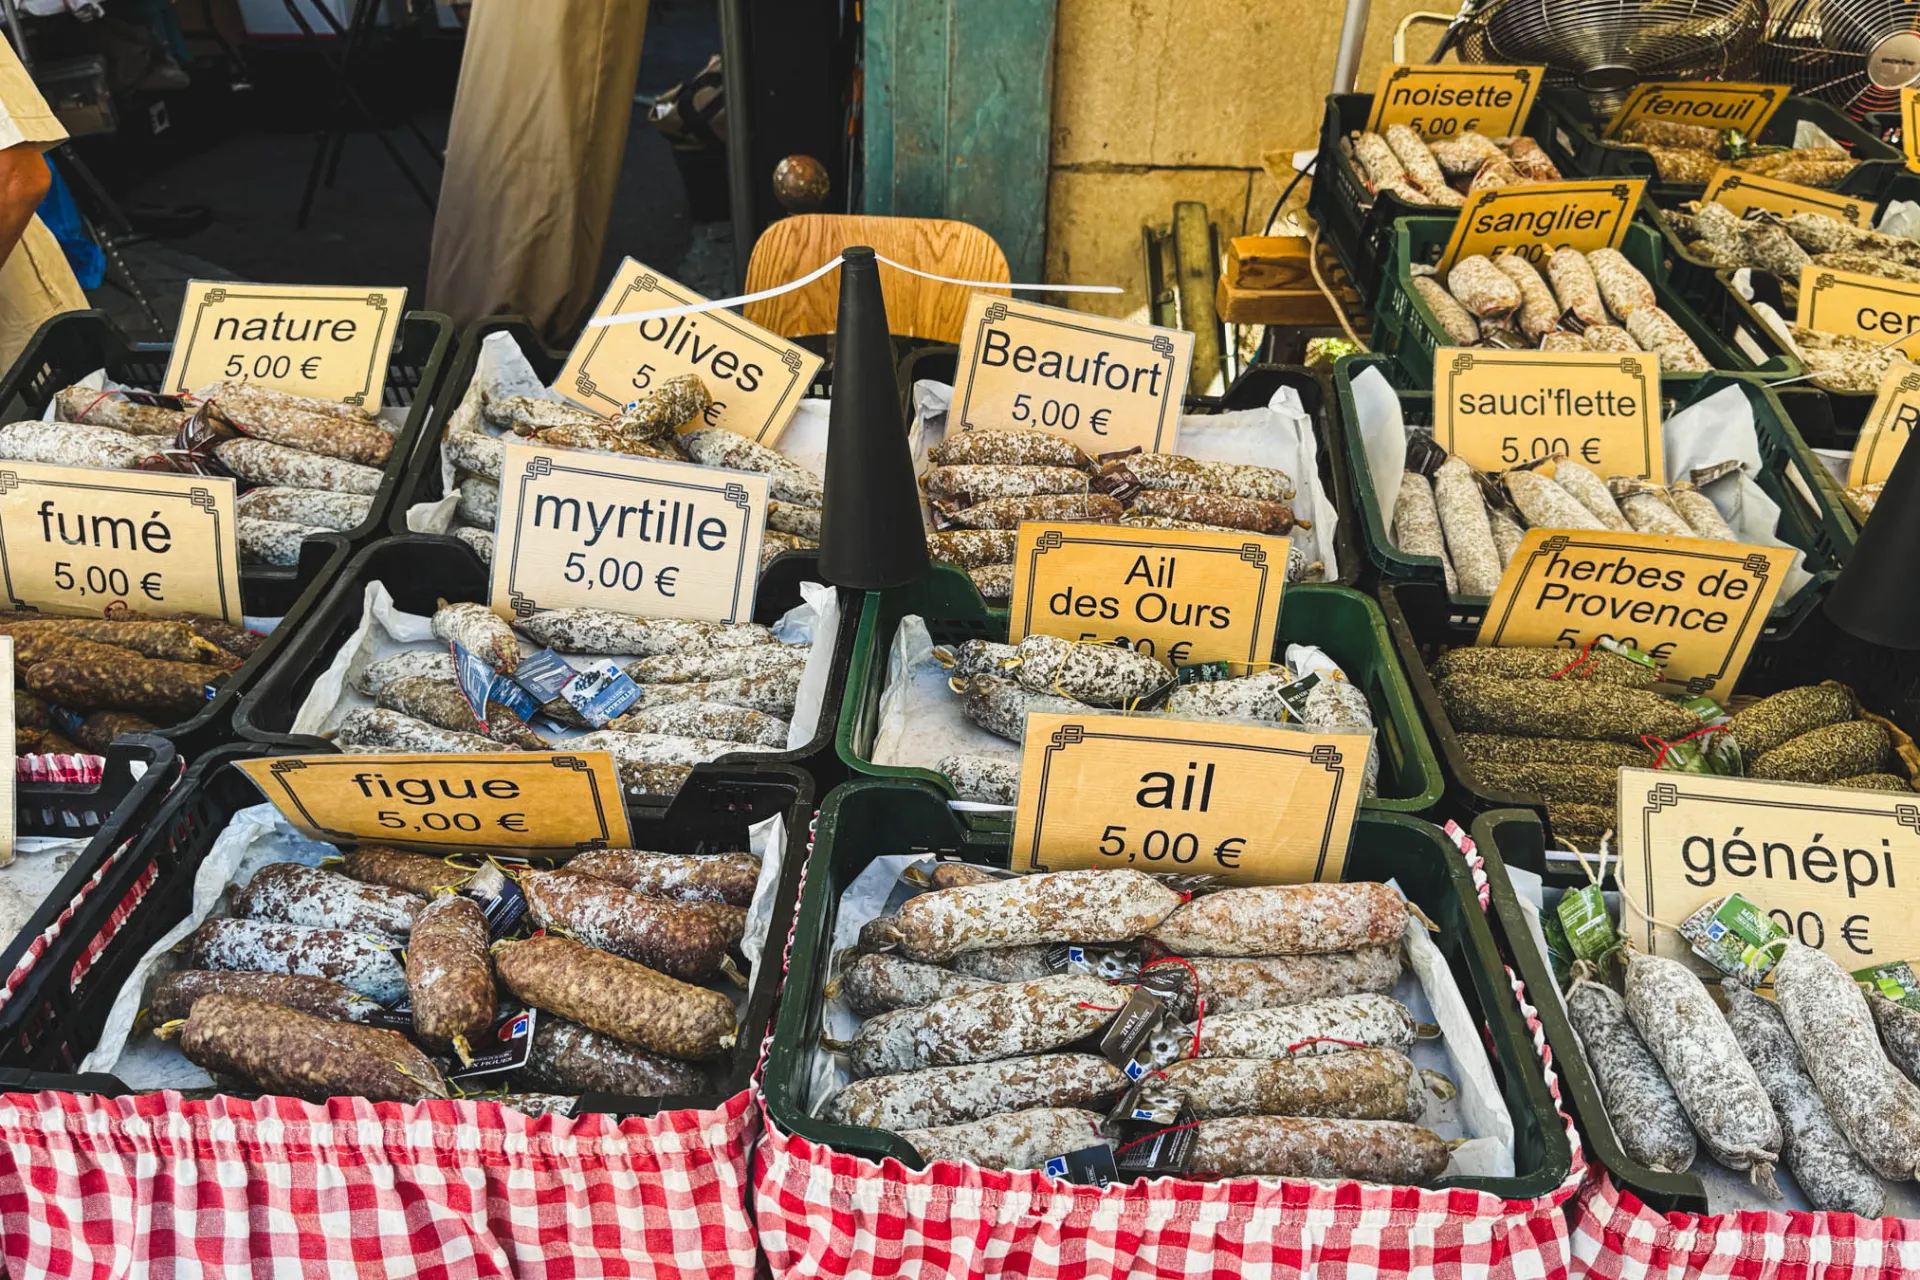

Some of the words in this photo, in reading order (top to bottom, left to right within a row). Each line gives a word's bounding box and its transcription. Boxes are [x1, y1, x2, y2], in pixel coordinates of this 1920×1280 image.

[1393, 84, 1513, 107] noisette
[1643, 95, 1755, 119] fenouil
[1409, 118, 1457, 137] 5,00
[1475, 204, 1611, 237] sanglier
[214, 311, 357, 342] nature
[224, 355, 291, 382] 5,00
[300, 356, 322, 379] €
[639, 315, 763, 392] olives
[982, 329, 1162, 396] Beaufort
[703, 402, 727, 427] €
[1012, 394, 1079, 430] 5,00
[1090, 409, 1112, 435] €
[1459, 388, 1636, 417] sauci'flette
[1580, 438, 1601, 464] €
[37, 500, 172, 554] fumé
[534, 494, 727, 551] myrtille
[55, 561, 129, 597] 5,00
[140, 572, 164, 601] €
[564, 552, 643, 591] 5,00
[654, 566, 680, 597] €
[1124, 555, 1176, 589] Ail
[1544, 551, 1685, 593] herbes
[1697, 569, 1749, 600] de
[1049, 587, 1119, 620] des
[1135, 593, 1231, 630] Ours
[1535, 583, 1728, 633] Provence
[351, 773, 520, 806] figue
[1136, 761, 1216, 813] ail
[378, 810, 482, 833] 5,00
[496, 813, 530, 833] €
[1099, 825, 1199, 864] 5,00
[1213, 837, 1247, 869] €
[1682, 826, 1896, 899] génépi
[1840, 914, 1874, 955] €
